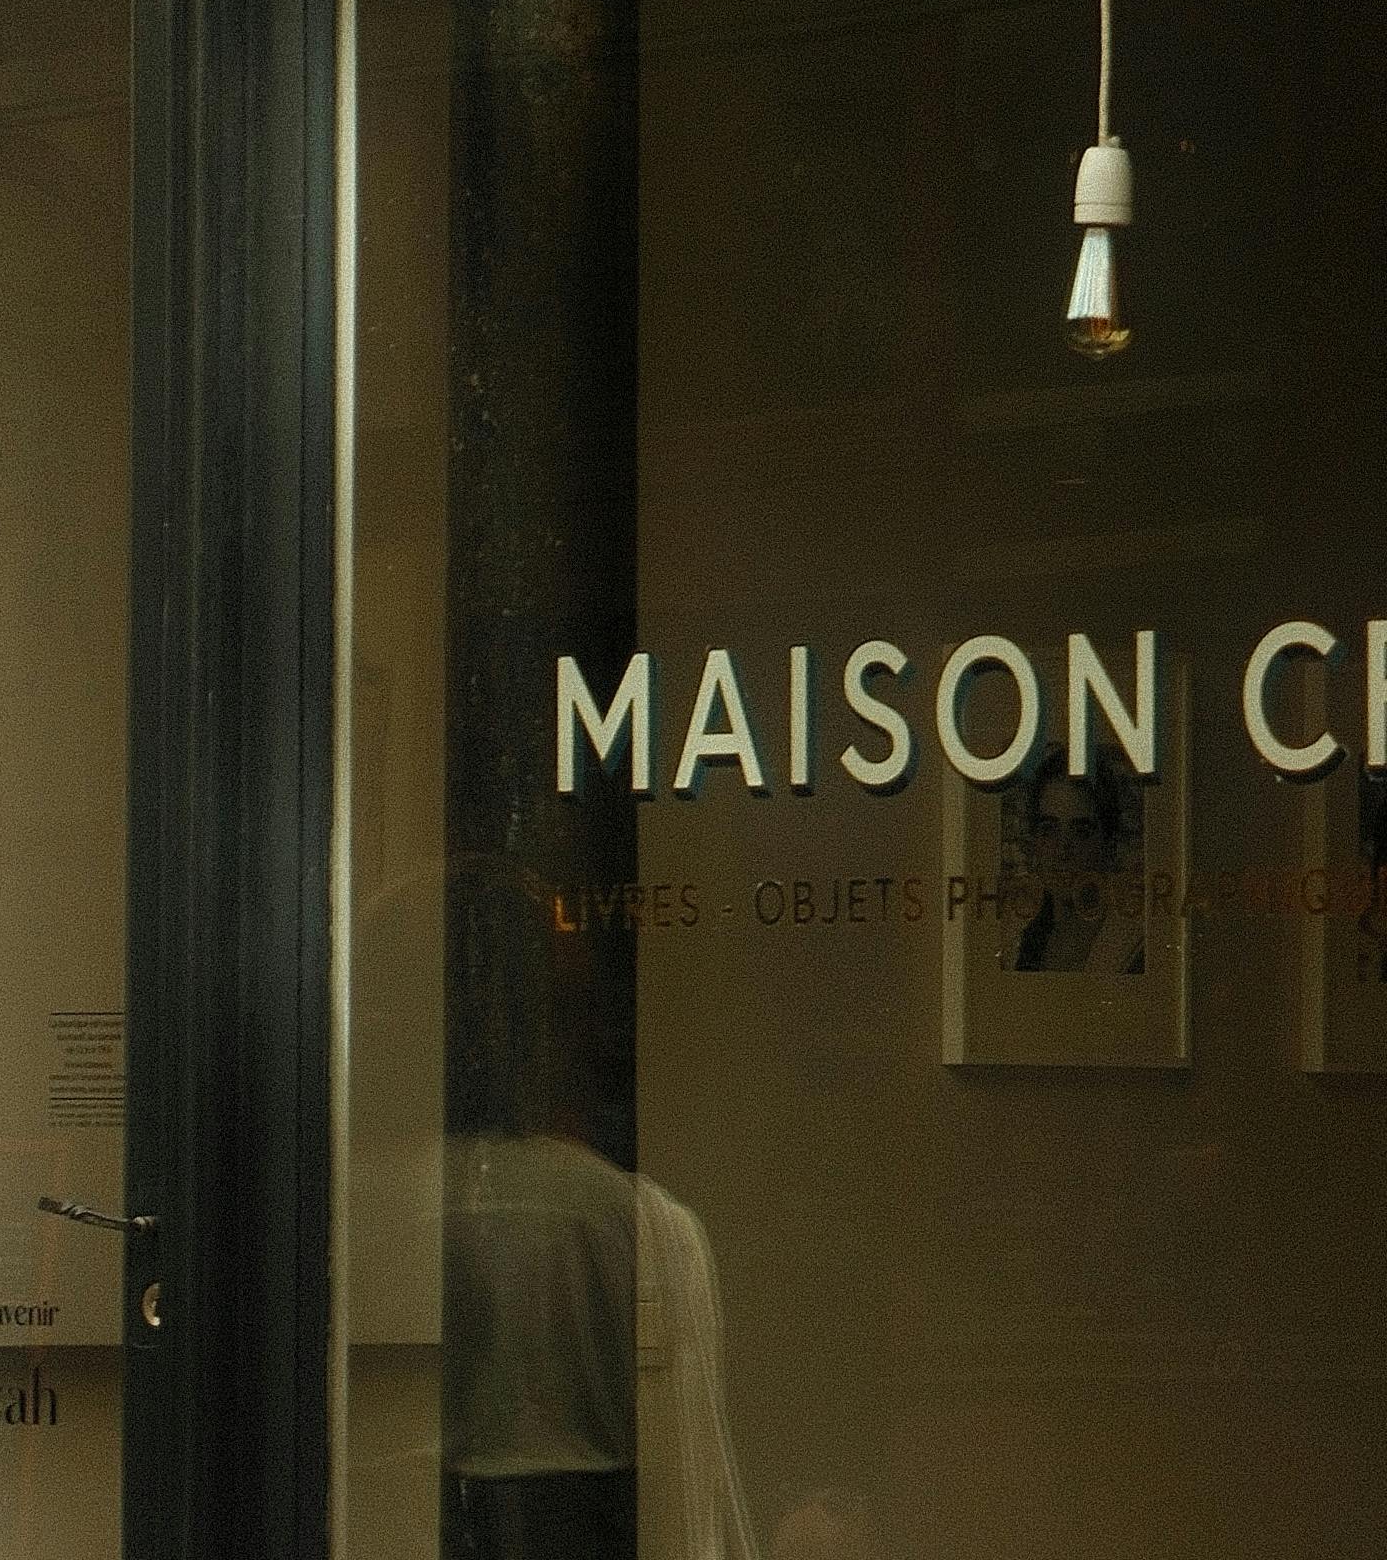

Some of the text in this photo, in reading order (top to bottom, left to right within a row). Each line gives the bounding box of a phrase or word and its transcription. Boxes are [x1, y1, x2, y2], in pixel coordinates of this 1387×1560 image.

[556, 620, 1387, 794] MAISON C
[554, 881, 702, 933] LIVRES
[755, 876, 924, 926] OBJETS
